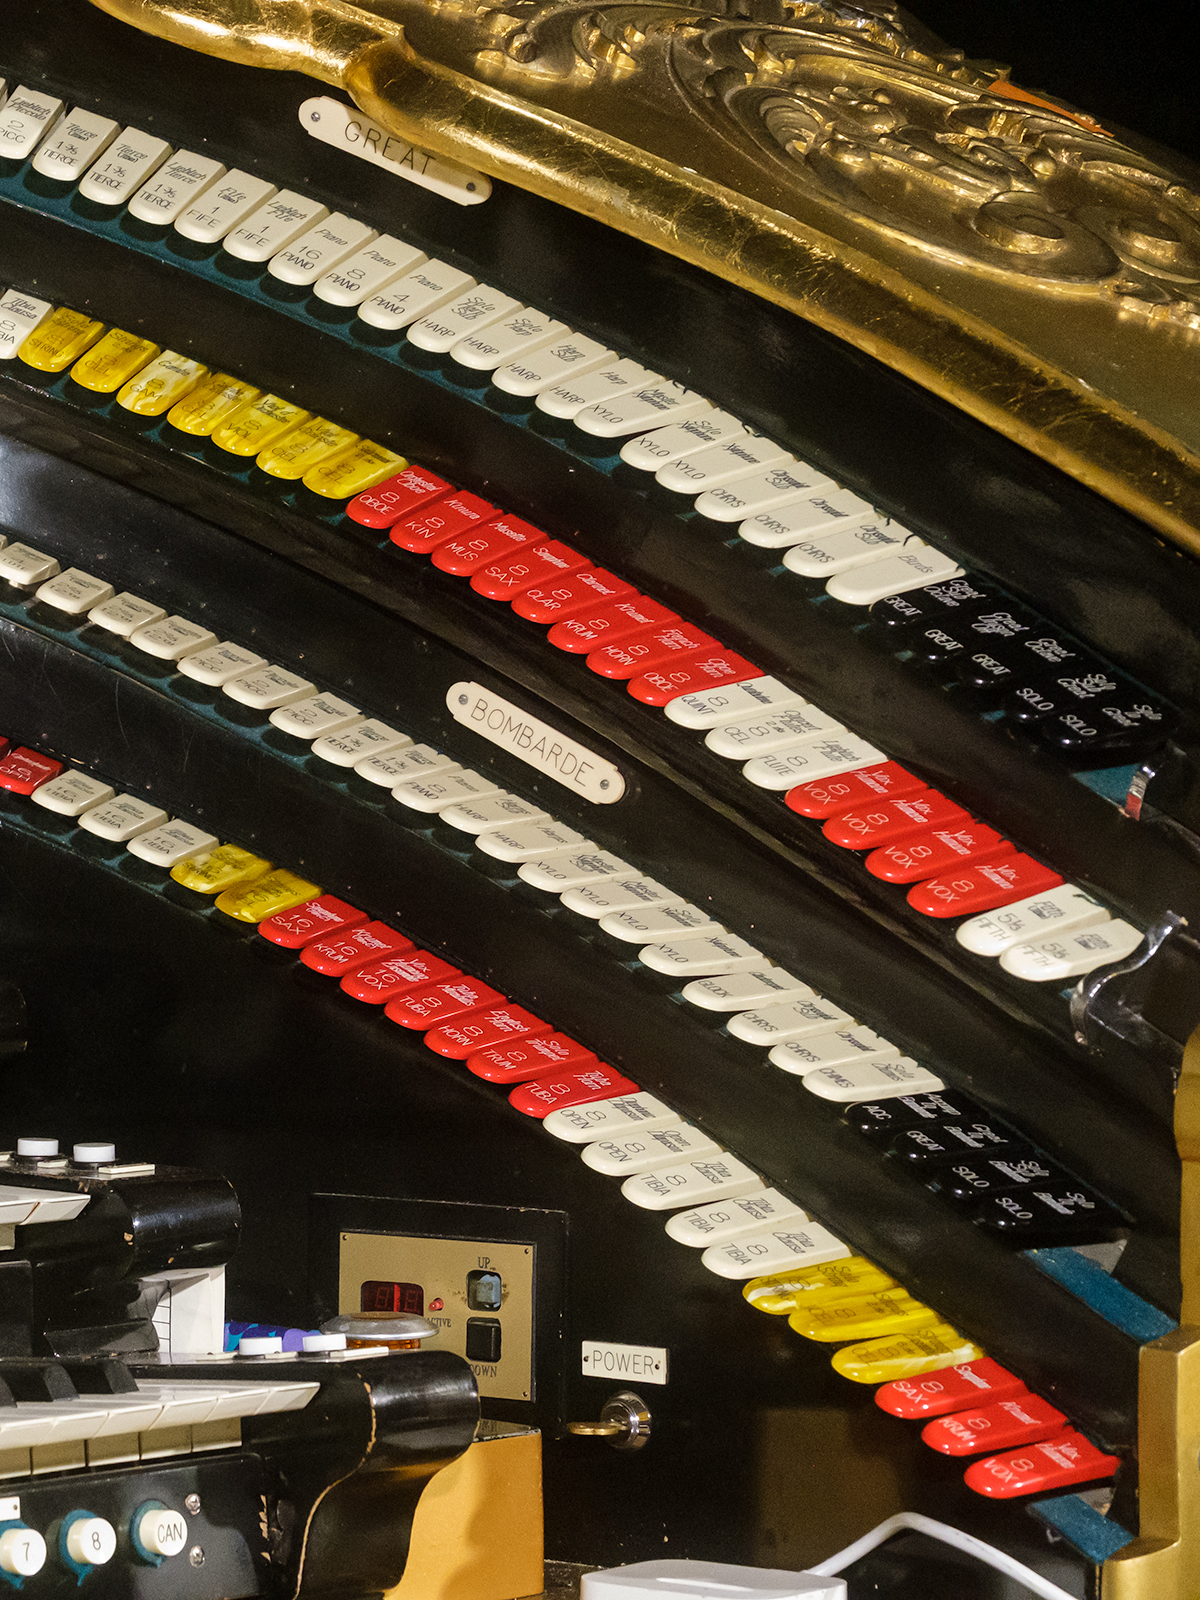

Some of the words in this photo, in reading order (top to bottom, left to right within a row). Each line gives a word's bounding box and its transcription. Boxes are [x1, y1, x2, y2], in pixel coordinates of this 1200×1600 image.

[345, 120, 436, 175] GREAT
[186, 209, 221, 228] FIFE
[280, 250, 315, 270] PIANO
[410, 274, 443, 292] Piano
[393, 294, 410, 302] 4
[419, 318, 456, 338] HARP
[590, 404, 623, 423] XYLO
[405, 521, 435, 538] KIN
[446, 542, 479, 562] MUS
[898, 554, 934, 574] Birds
[486, 566, 520, 587] SAX
[884, 596, 922, 616] GREAT
[562, 619, 598, 640] KRUM
[602, 645, 636, 666] HORN
[681, 695, 716, 715] QUINT
[1016, 688, 1054, 710] SOLO
[471, 698, 594, 787] BOMBARDE
[804, 784, 836, 805] VOX
[536, 861, 566, 880] XYLO
[271, 916, 306, 934] SAX
[356, 970, 388, 990] VOX
[400, 996, 430, 1018] TUBA
[438, 1026, 474, 1046] HORN
[483, 1050, 516, 1070] TRUM
[785, 1042, 820, 1062] CHRYS
[907, 1130, 945, 1152] GREAT
[599, 1142, 632, 1162] OPEN
[996, 1197, 1032, 1219] SOLO
[684, 1212, 715, 1234] TIBIA
[478, 1257, 490, 1268] UP
[592, 1350, 654, 1375] POWER
[893, 1381, 928, 1404] SAX
[984, 1459, 1020, 1482] VOX
[92, 1532, 101, 1550] 8
[158, 1524, 183, 1542] CAN
[22, 1542, 30, 1561] 7
